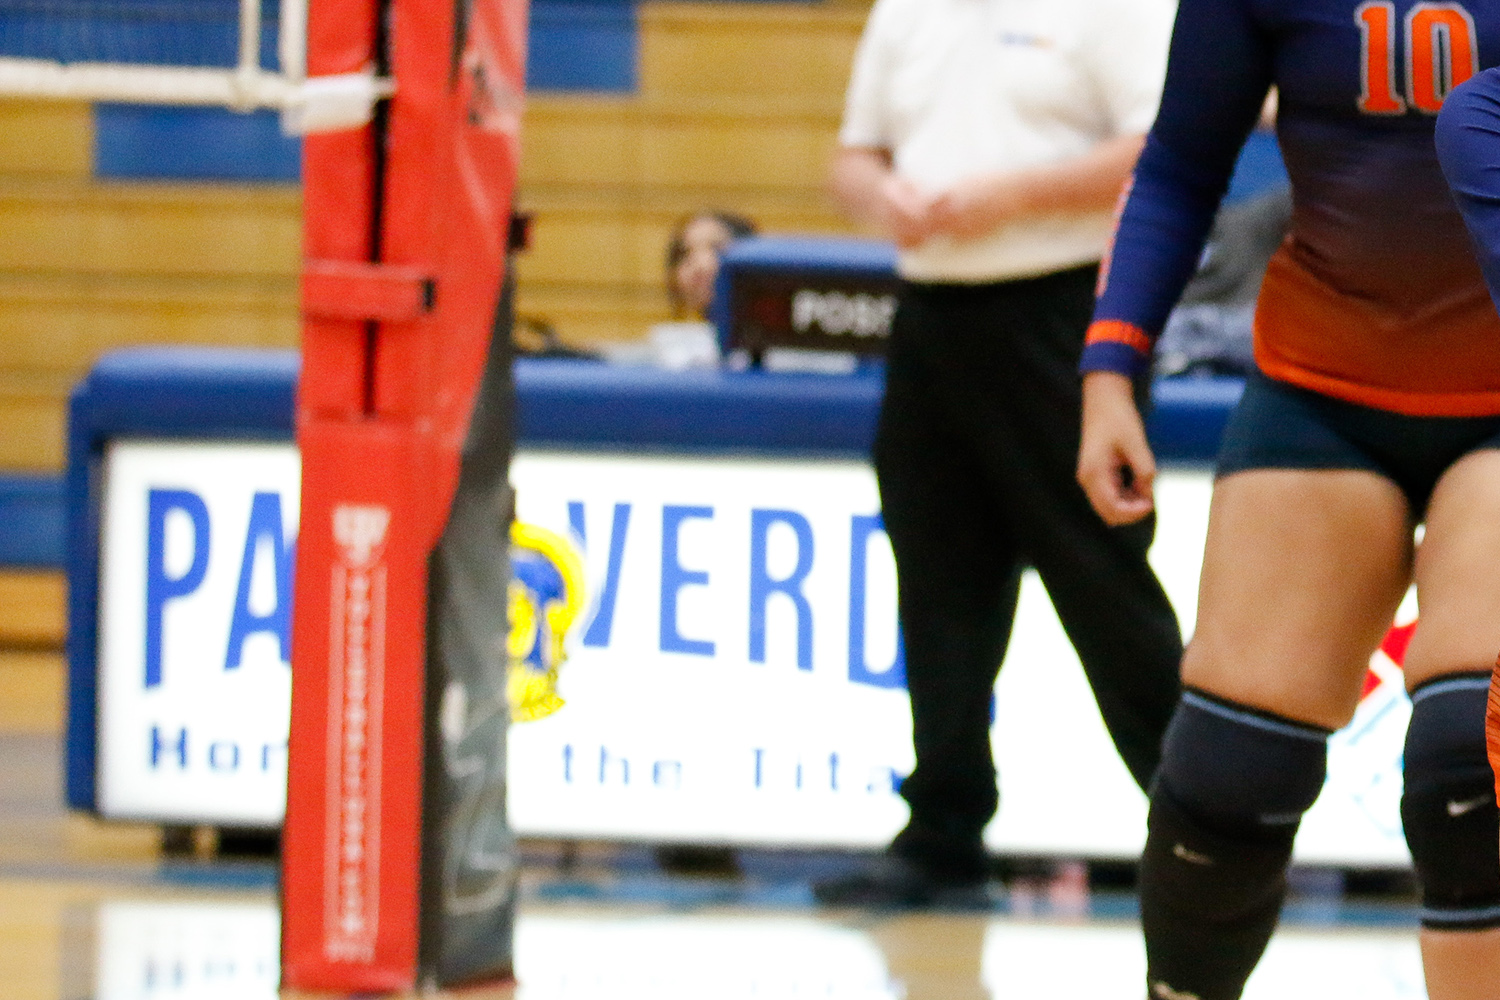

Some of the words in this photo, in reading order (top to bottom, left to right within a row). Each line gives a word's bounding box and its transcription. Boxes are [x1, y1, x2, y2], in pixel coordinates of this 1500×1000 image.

[1354, 0, 1479, 115] 10
[145, 488, 296, 689] PA
[567, 501, 910, 690] VERD
[149, 725, 288, 772] Ho
[753, 748, 906, 795] Tita
